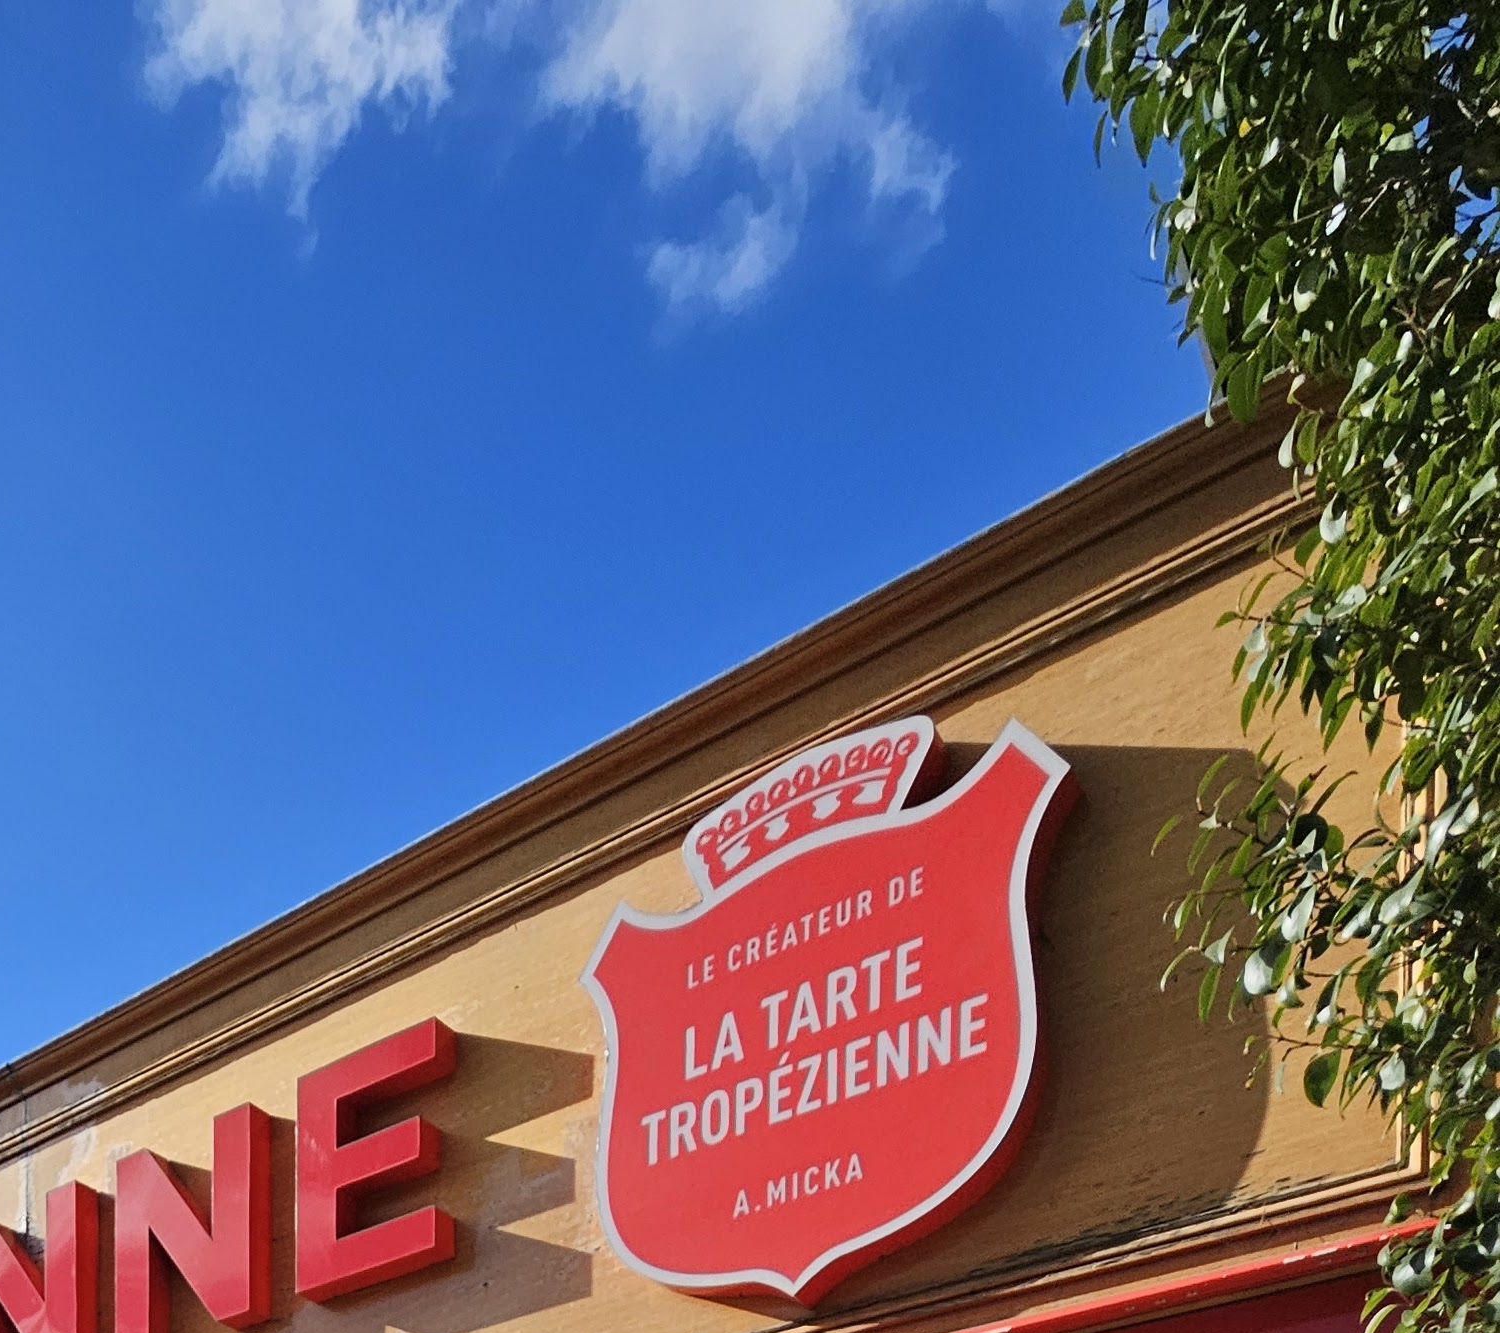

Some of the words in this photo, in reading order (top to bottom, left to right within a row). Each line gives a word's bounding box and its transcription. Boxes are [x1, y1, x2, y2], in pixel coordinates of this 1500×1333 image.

[686, 954, 715, 989] LE
[727, 889, 873, 972] CRÉATEUR
[888, 867, 923, 907] DE
[683, 1010, 745, 1081] LA
[760, 936, 925, 1051] TARTE
[640, 992, 990, 1167] TROPÉZIENNE
[731, 1152, 864, 1220] A.MICKA
